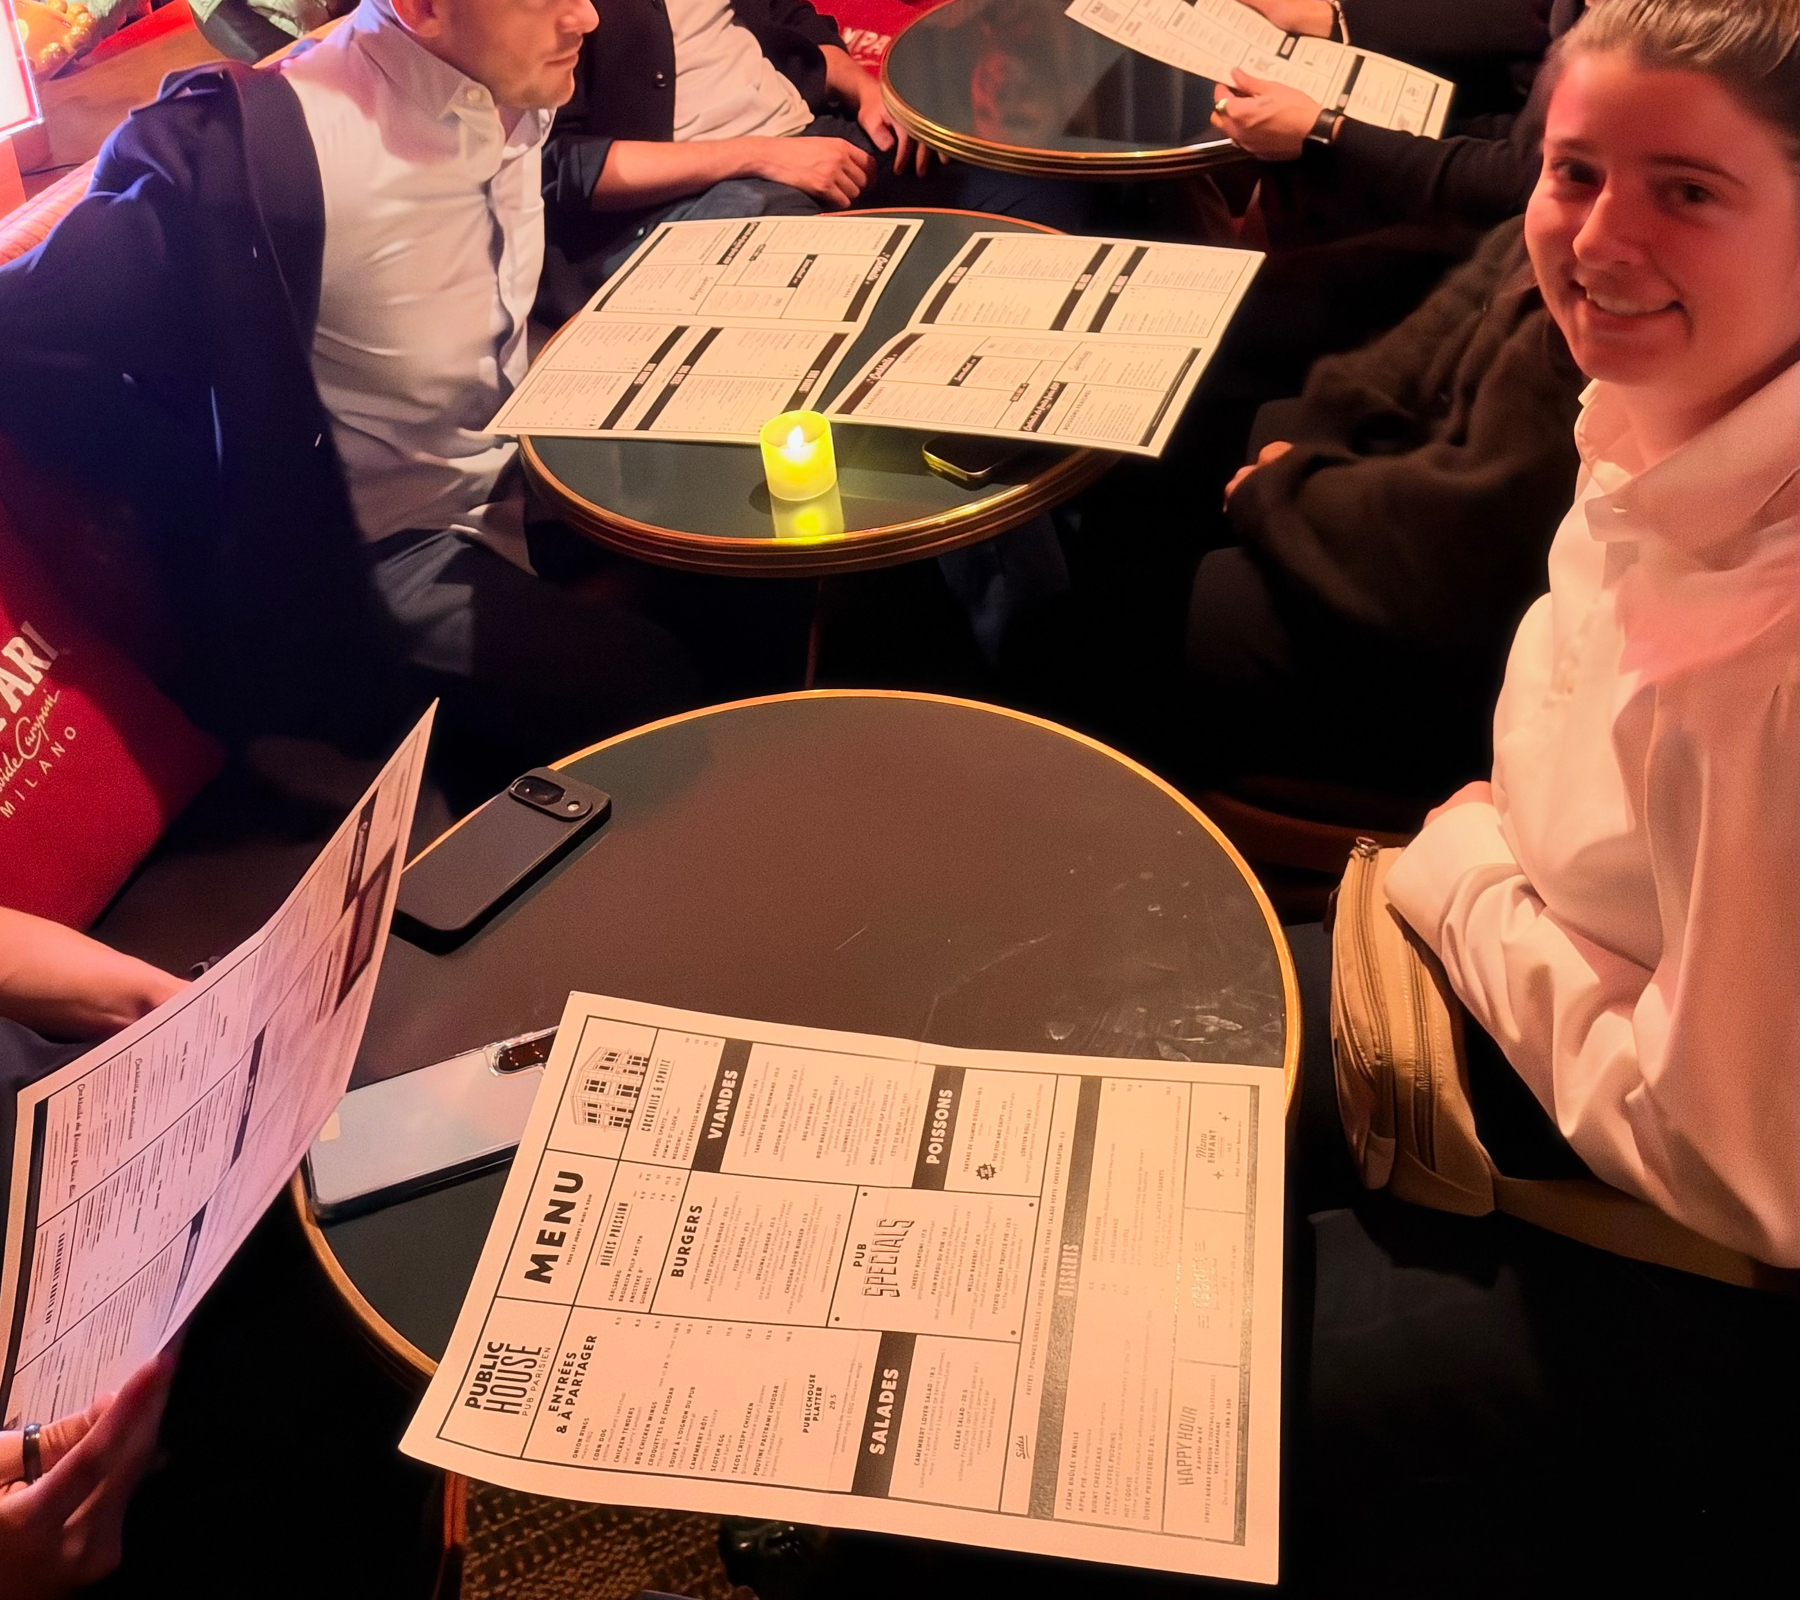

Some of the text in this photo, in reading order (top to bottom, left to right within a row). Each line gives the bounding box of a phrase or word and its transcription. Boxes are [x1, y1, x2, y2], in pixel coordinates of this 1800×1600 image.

[870, 356, 896, 379] Cocktails
[0, 620, 58, 731] ARI
[15, 688, 60, 760] Campari
[0, 726, 76, 818] MILANO
[76, 1083, 86, 1120] Cocktails
[641, 1094, 660, 1131] COCKTAILS
[655, 1059, 670, 1083] SPRITZ
[707, 1070, 739, 1139] VIANDES
[652, 1117, 667, 1156] APEROL SPRITZ
[671, 1136, 681, 1159] NEGRONI
[682, 1092, 703, 1160] VELVET EXPRESSO MARTINI
[926, 1088, 952, 1164] POISSONS
[1195, 1132, 1207, 1158] Menu
[1207, 1129, 1216, 1163] ENFANT
[524, 1171, 583, 1283] MENU
[600, 1202, 628, 1266] BIÈRES PRESSION
[670, 1205, 702, 1277] BURGERS
[703, 1222, 724, 1284] FRIED CHICKEN BURGER
[736, 1236, 745, 1257] BURGER
[618, 1273, 631, 1301] BROOKLYN
[627, 1257, 635, 1271] PULP
[755, 1232, 771, 1280] ORIGINAL BURGER
[784, 1268, 794, 1293] CHEDDAR
[795, 1228, 804, 1248] BURGER
[852, 1243, 866, 1267] PUB
[863, 1219, 914, 1297] SPECIALS
[910, 1243, 923, 1289] CHEESY RIGATONI
[933, 1262, 941, 1280] PERDU
[936, 1253, 943, 1261] DU
[1058, 1244, 1078, 1296] DESSERTS
[607, 1269, 621, 1300] CARLSBERG
[639, 1277, 651, 1304] GUINNESS
[464, 1341, 504, 1408] PUBLIC
[483, 1343, 541, 1414] HOUSE
[521, 1347, 550, 1416] PUB PARISIEN
[548, 1352, 576, 1411] ENTRÉES
[555, 1335, 596, 1433] & À PARTAGER
[687, 1386, 695, 1398] PUB
[828, 1394, 836, 1409] 29.5
[647, 1387, 673, 1465] CROQUETTES DE CHEDDAR
[676, 1410, 688, 1439] L'OIGNON
[684, 1400, 691, 1408] DU
[752, 1385, 778, 1475] POUTINE PASTRAMI CHEDDAR
[802, 1374, 818, 1433] PUBLICHOUSE
[812, 1386, 822, 1421] PLATTER
[869, 1368, 899, 1454] SALADES
[913, 1427, 924, 1465] CAMEMBERT
[924, 1383, 932, 1402] SALAD
[572, 1417, 589, 1458] ONION RINGS
[592, 1428, 606, 1460] CORN DOG
[613, 1407, 634, 1462] CHICKEN TENDERS
[634, 1401, 657, 1464] BBQ CHICKEN WINGS
[668, 1448, 678, 1467] SOUPE
[689, 1415, 708, 1469] CAMEMBERT RÔTI
[710, 1434, 725, 1471] SCOTCH EGG
[731, 1402, 753, 1473] TACOS CRISPY CHICKEN
[1015, 1434, 1028, 1459] Sides
[1176, 1406, 1197, 1485] HAPPY HOUR
